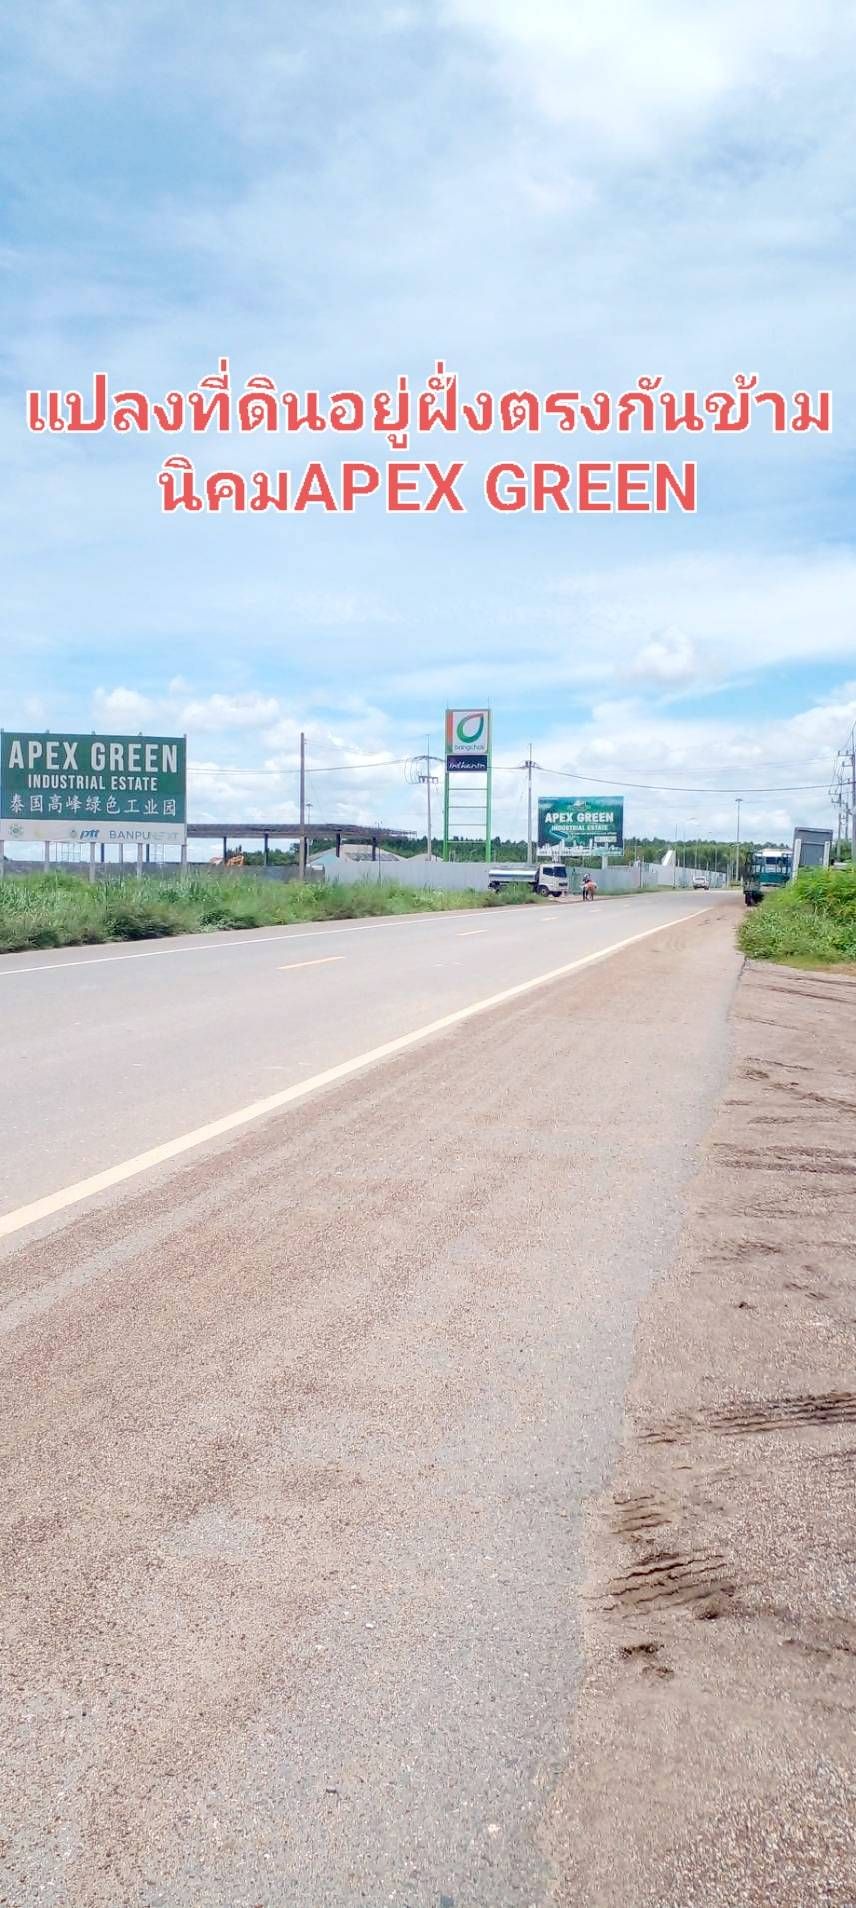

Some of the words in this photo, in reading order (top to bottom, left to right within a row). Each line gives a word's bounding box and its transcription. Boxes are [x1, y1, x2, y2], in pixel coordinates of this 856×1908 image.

[8, 740, 79, 771] APEX
[90, 742, 178, 773] GREEN
[28, 774, 106, 790] INDUSTRIAL
[111, 777, 158, 791] ESTATE
[10, 793, 176, 817] 泰国高峰绿色工业园
[545, 812, 574, 823] APEX
[577, 812, 614, 822] GREEN
[80, 829, 100, 839] ptt
[109, 830, 150, 841] BANPU
